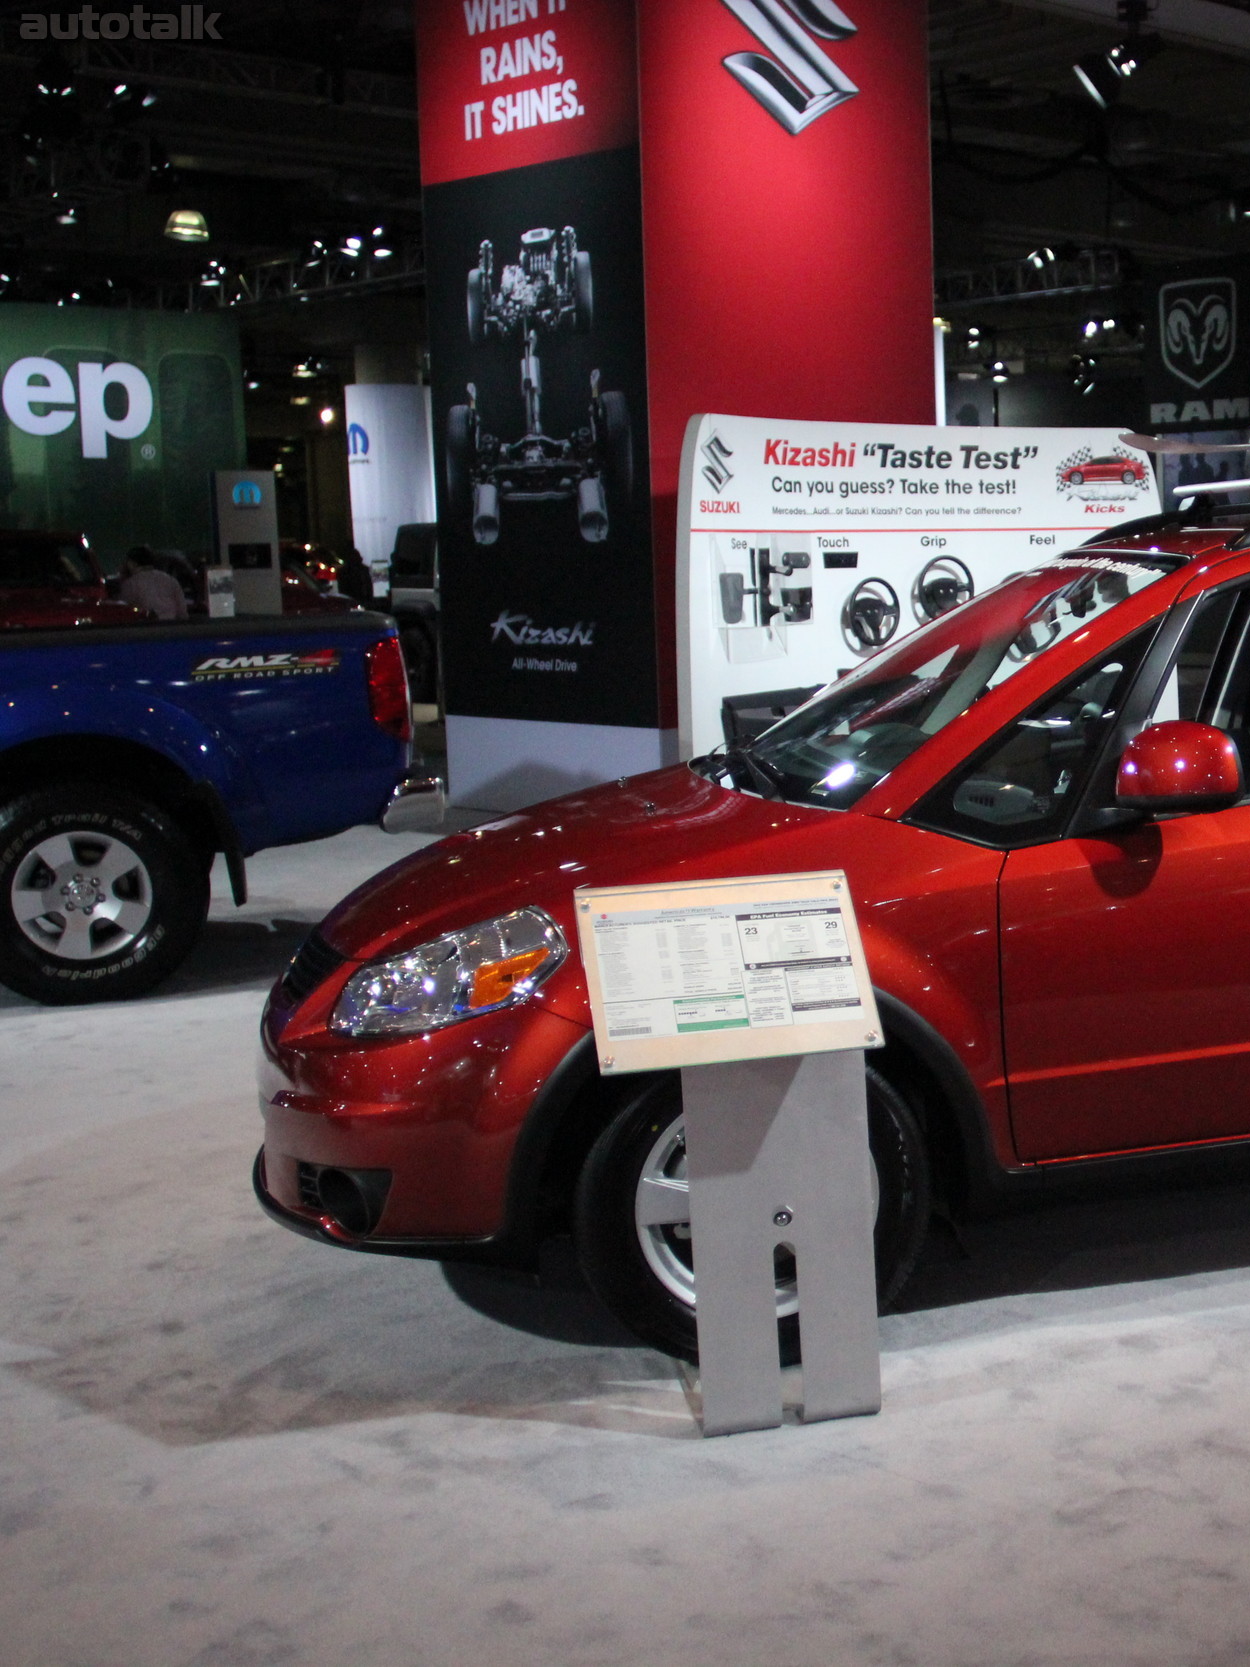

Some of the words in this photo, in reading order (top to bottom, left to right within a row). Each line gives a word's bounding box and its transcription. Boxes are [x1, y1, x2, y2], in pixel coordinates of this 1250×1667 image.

[463, 0, 538, 36] WHEN
[480, 29, 564, 86] RAINS,
[464, 101, 485, 141] IT
[491, 78, 585, 135] SHINES.
[2, 356, 153, 459] ep
[1150, 397, 1250, 424] RAM
[764, 438, 856, 468] Kizashi
[863, 443, 952, 469] “Taste
[960, 444, 1038, 470] Test”
[771, 476, 802, 493] Can
[807, 480, 834, 497] you
[839, 478, 895, 499] guess?
[899, 478, 939, 494] Take
[945, 479, 973, 494] the
[978, 479, 1016, 494] test!
[700, 499, 740, 514] SUZUKI
[845, 507, 868, 515] Suzuki
[871, 507, 902, 515] Kizashi?
[905, 507, 923, 515] Can
[925, 508, 940, 517] you
[942, 506, 955, 515] tell
[957, 506, 970, 515] the
[973, 506, 1022, 515] difference?
[1084, 504, 1125, 513] Kicks
[731, 538, 748, 550] See
[817, 536, 850, 548] Touch
[920, 535, 947, 548] Grip
[1029, 535, 1056, 545] Feel
[490, 608, 597, 646] Kizashi
[512, 657, 553, 672] All-Wheel
[555, 658, 578, 673] Drive
[195, 674, 226, 682] OFF
[233, 670, 276, 679] ROAD
[282, 666, 334, 676] SPORT
[775, 911, 800, 919] Economy
[800, 909, 828, 917] Estimates
[744, 927, 758, 935] 23
[824, 921, 838, 929] 29
